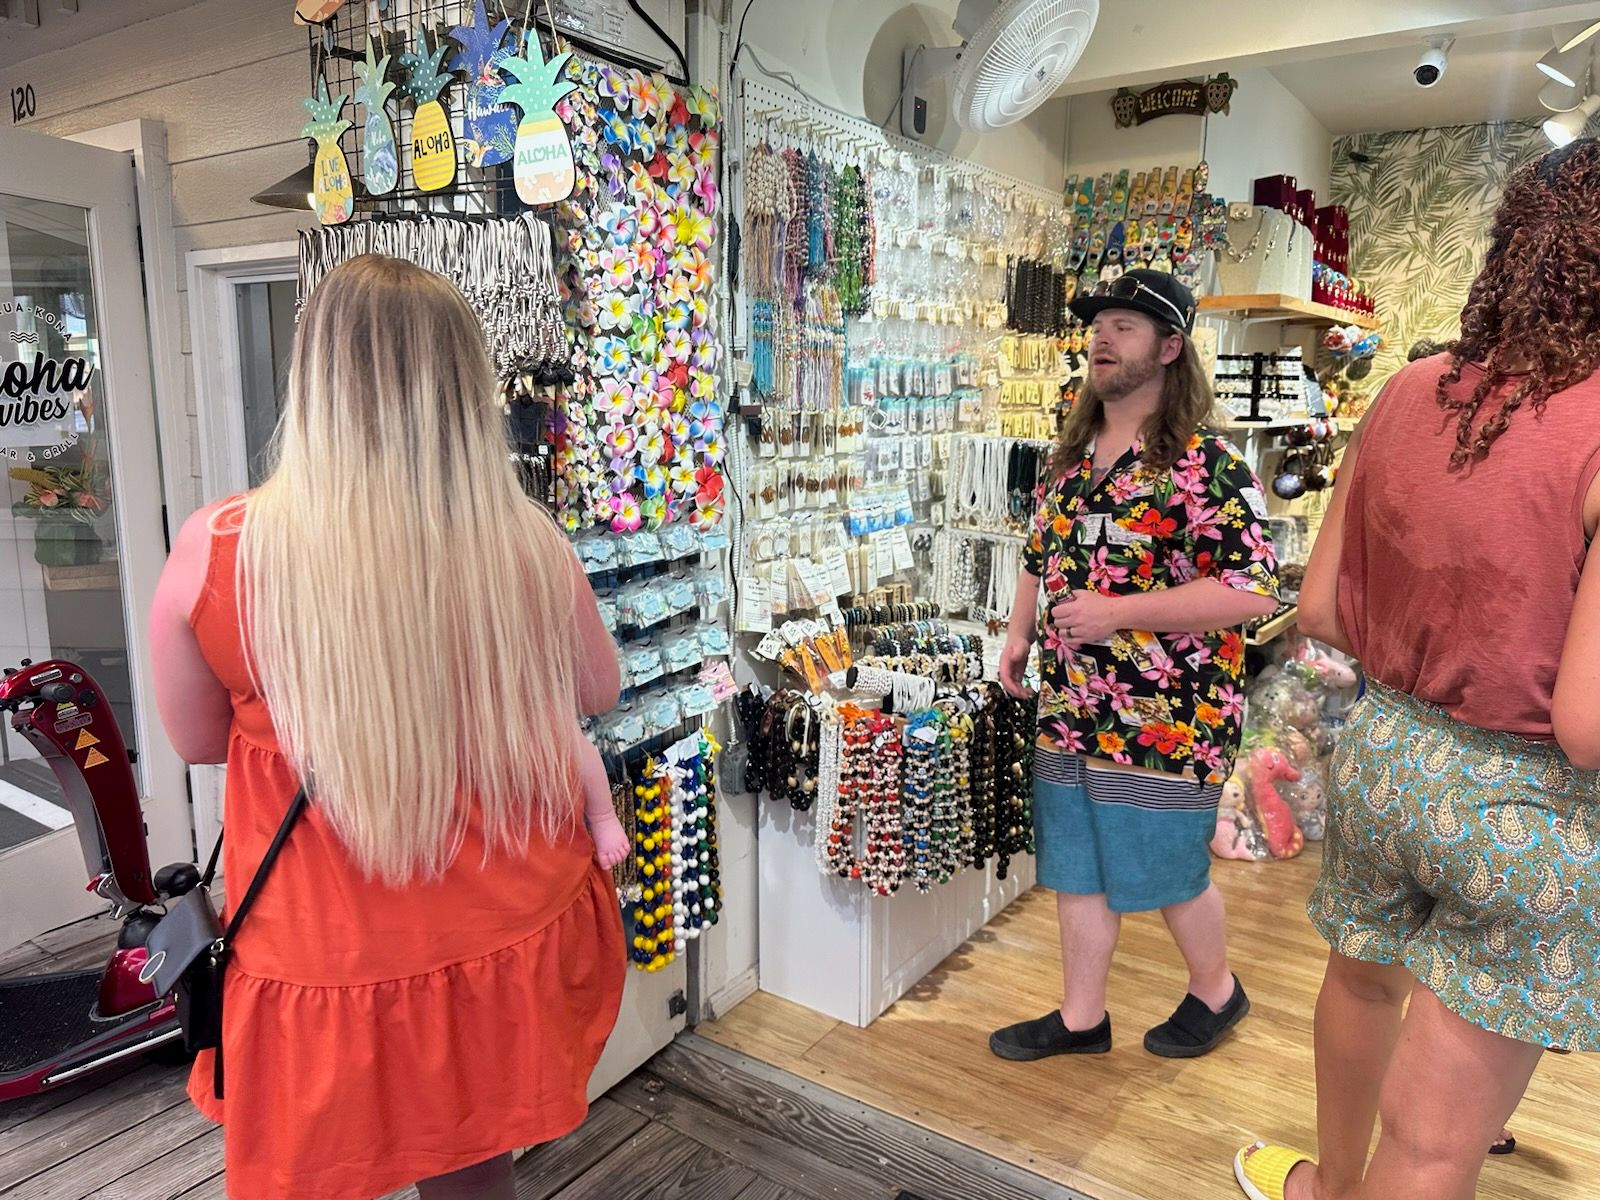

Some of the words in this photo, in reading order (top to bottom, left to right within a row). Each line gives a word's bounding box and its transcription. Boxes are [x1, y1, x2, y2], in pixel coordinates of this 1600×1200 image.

[11, 83, 36, 124] 120
[1140, 88, 1200, 113] WELCOME
[517, 143, 568, 166] ALOHA
[27, 453, 36, 462] &
[44, 432, 80, 460] GRILL
